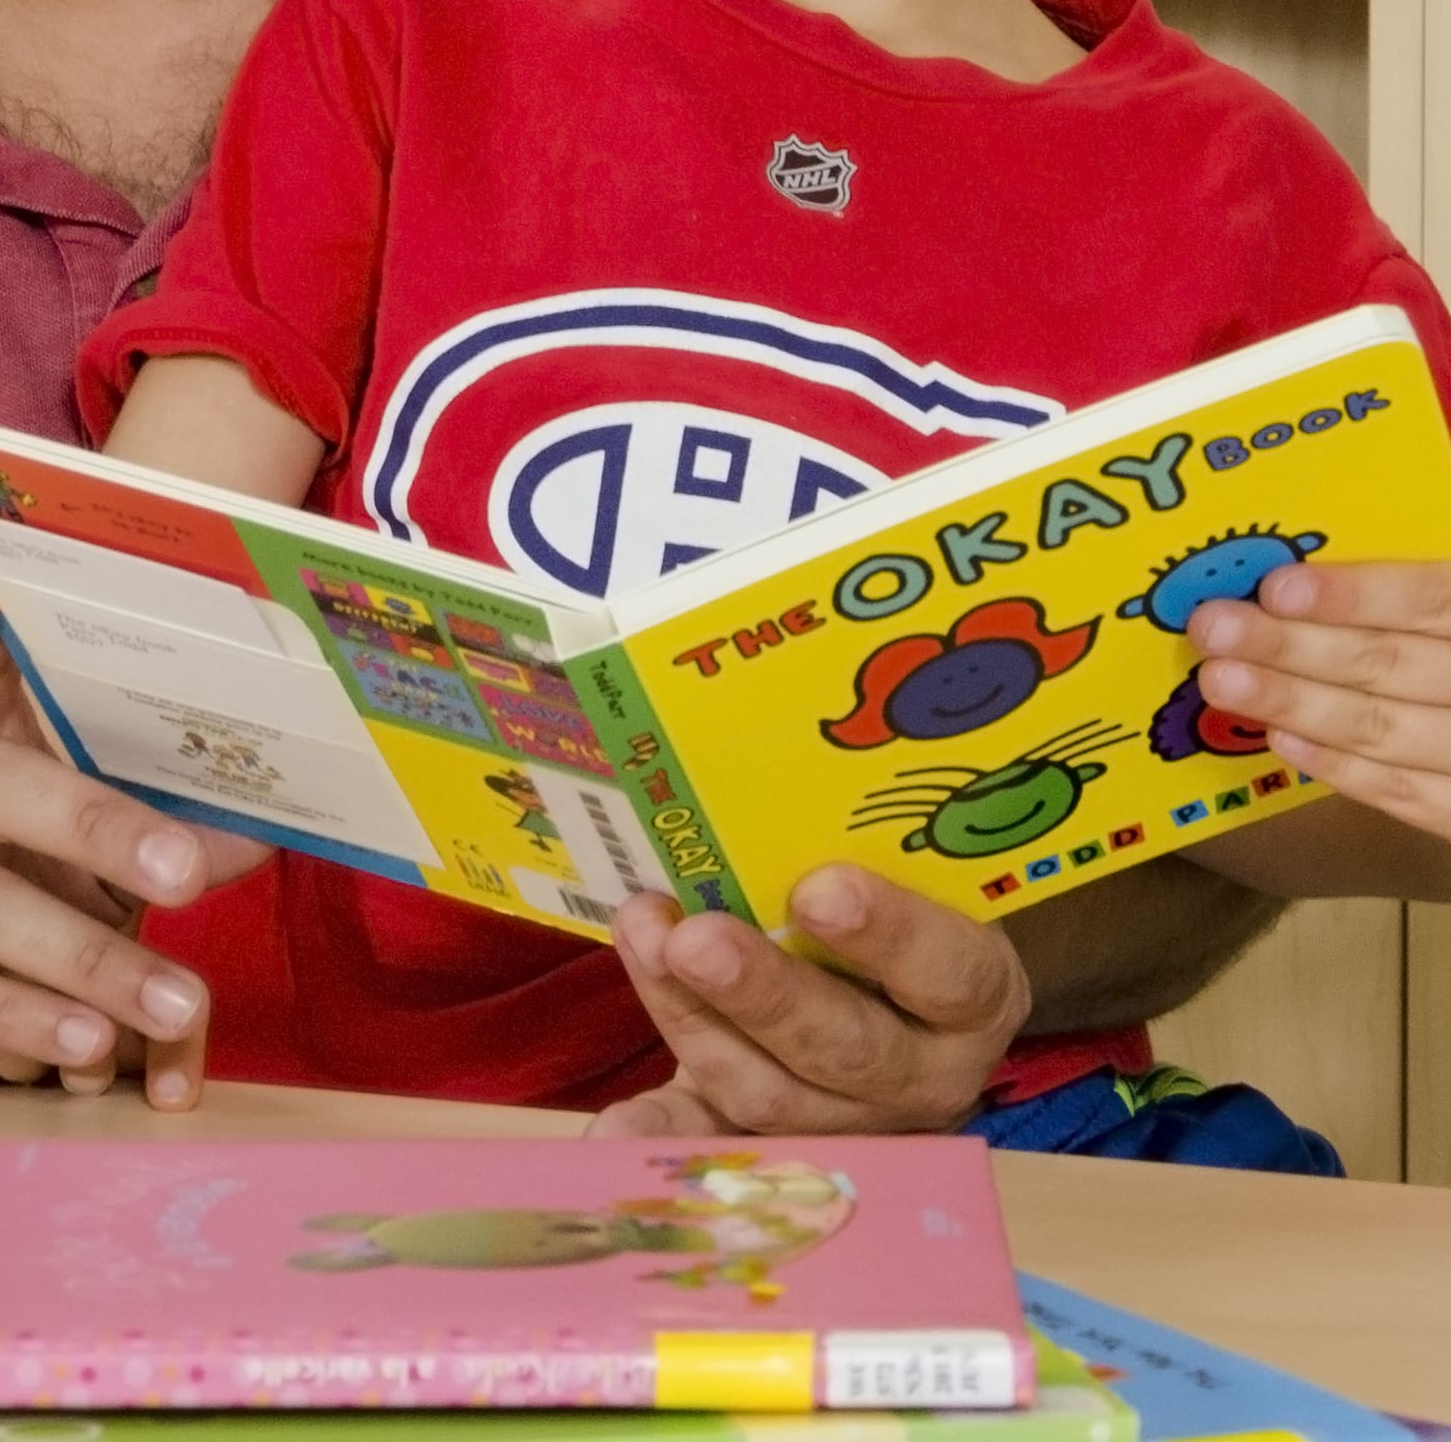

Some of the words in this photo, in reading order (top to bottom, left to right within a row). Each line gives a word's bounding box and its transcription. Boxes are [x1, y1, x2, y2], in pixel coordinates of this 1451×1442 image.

[782, 168, 837, 189] NHL
[672, 600, 828, 679] THE
[832, 431, 1195, 622] OKAY
[1204, 386, 1391, 474] BOOK
[651, 806, 725, 879] OKAY
[980, 822, 1145, 901] TODD
[1169, 766, 1313, 828] PAR
